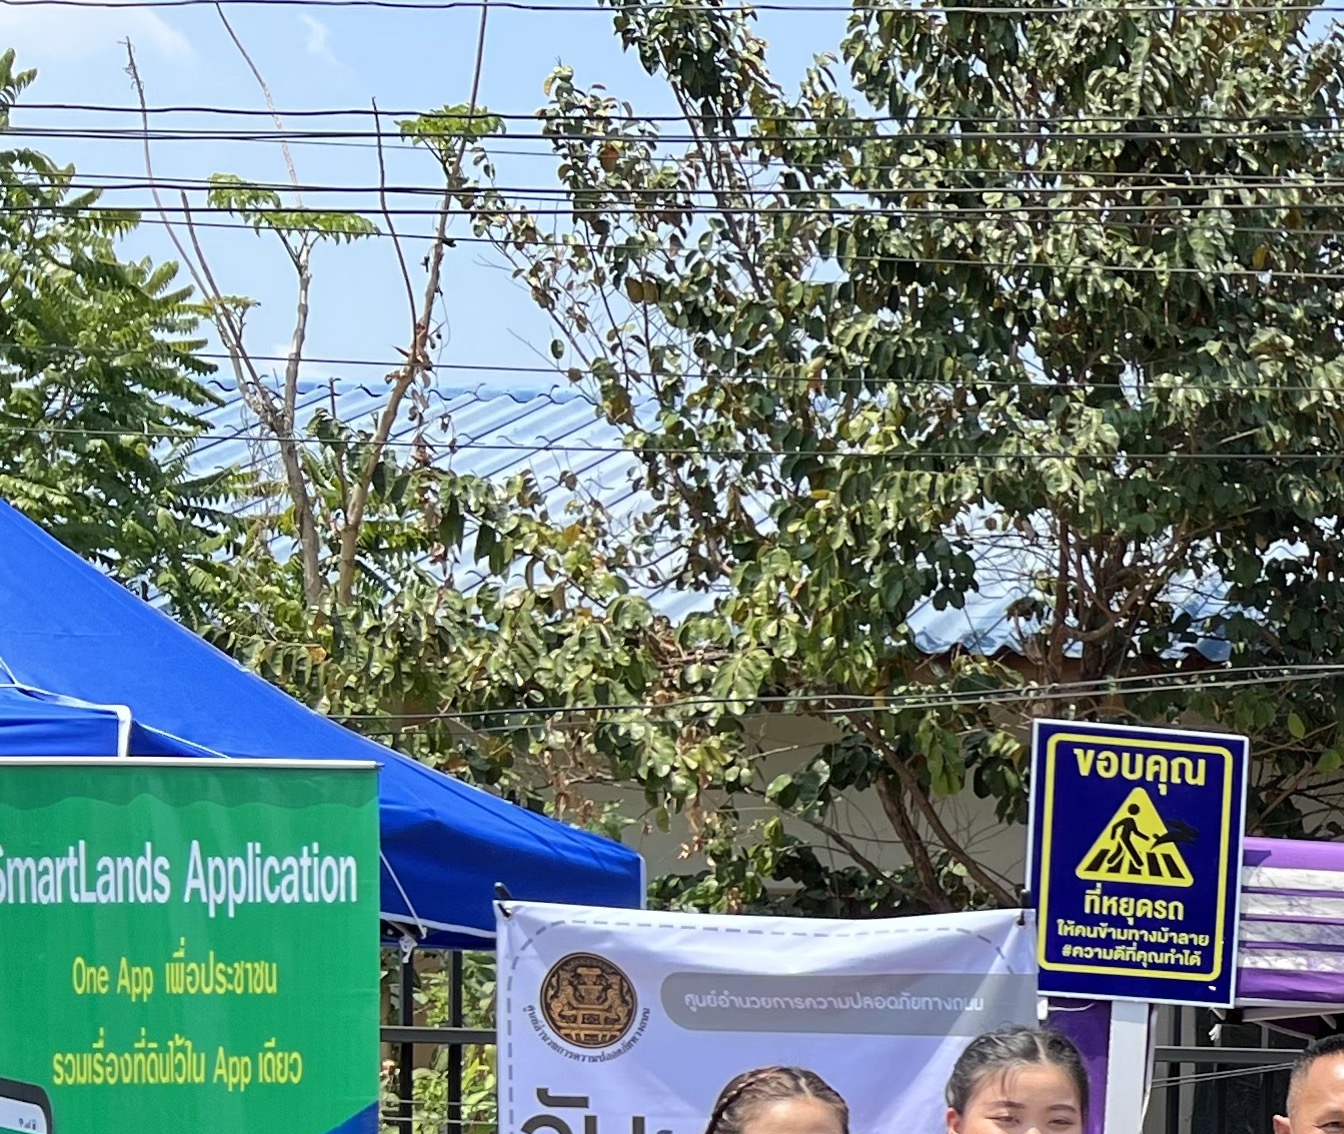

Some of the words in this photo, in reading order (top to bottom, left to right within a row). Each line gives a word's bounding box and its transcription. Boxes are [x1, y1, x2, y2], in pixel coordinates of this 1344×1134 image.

[1073, 747, 1206, 796] ขอบคุณ
[184, 839, 358, 918] Application
[1084, 883, 1185, 925] ที่หยุดรถ
[1057, 918, 1210, 947] ให้คนข้ามทางม้าลาย
[72, 956, 110, 994] One
[117, 957, 154, 1002] App
[165, 937, 278, 994] เพื่อประชาชน
[1062, 944, 1202, 968] #ความดีที่คุณทำได้
[684, 990, 985, 1013] ศูนย์อำนวยการความปลอดภัยทางถนน
[53, 1027, 205, 1085] รวมเรื่องที่ดินไว้ใน
[213, 1046, 252, 1092] App
[258, 1037, 304, 1084] เดียว
